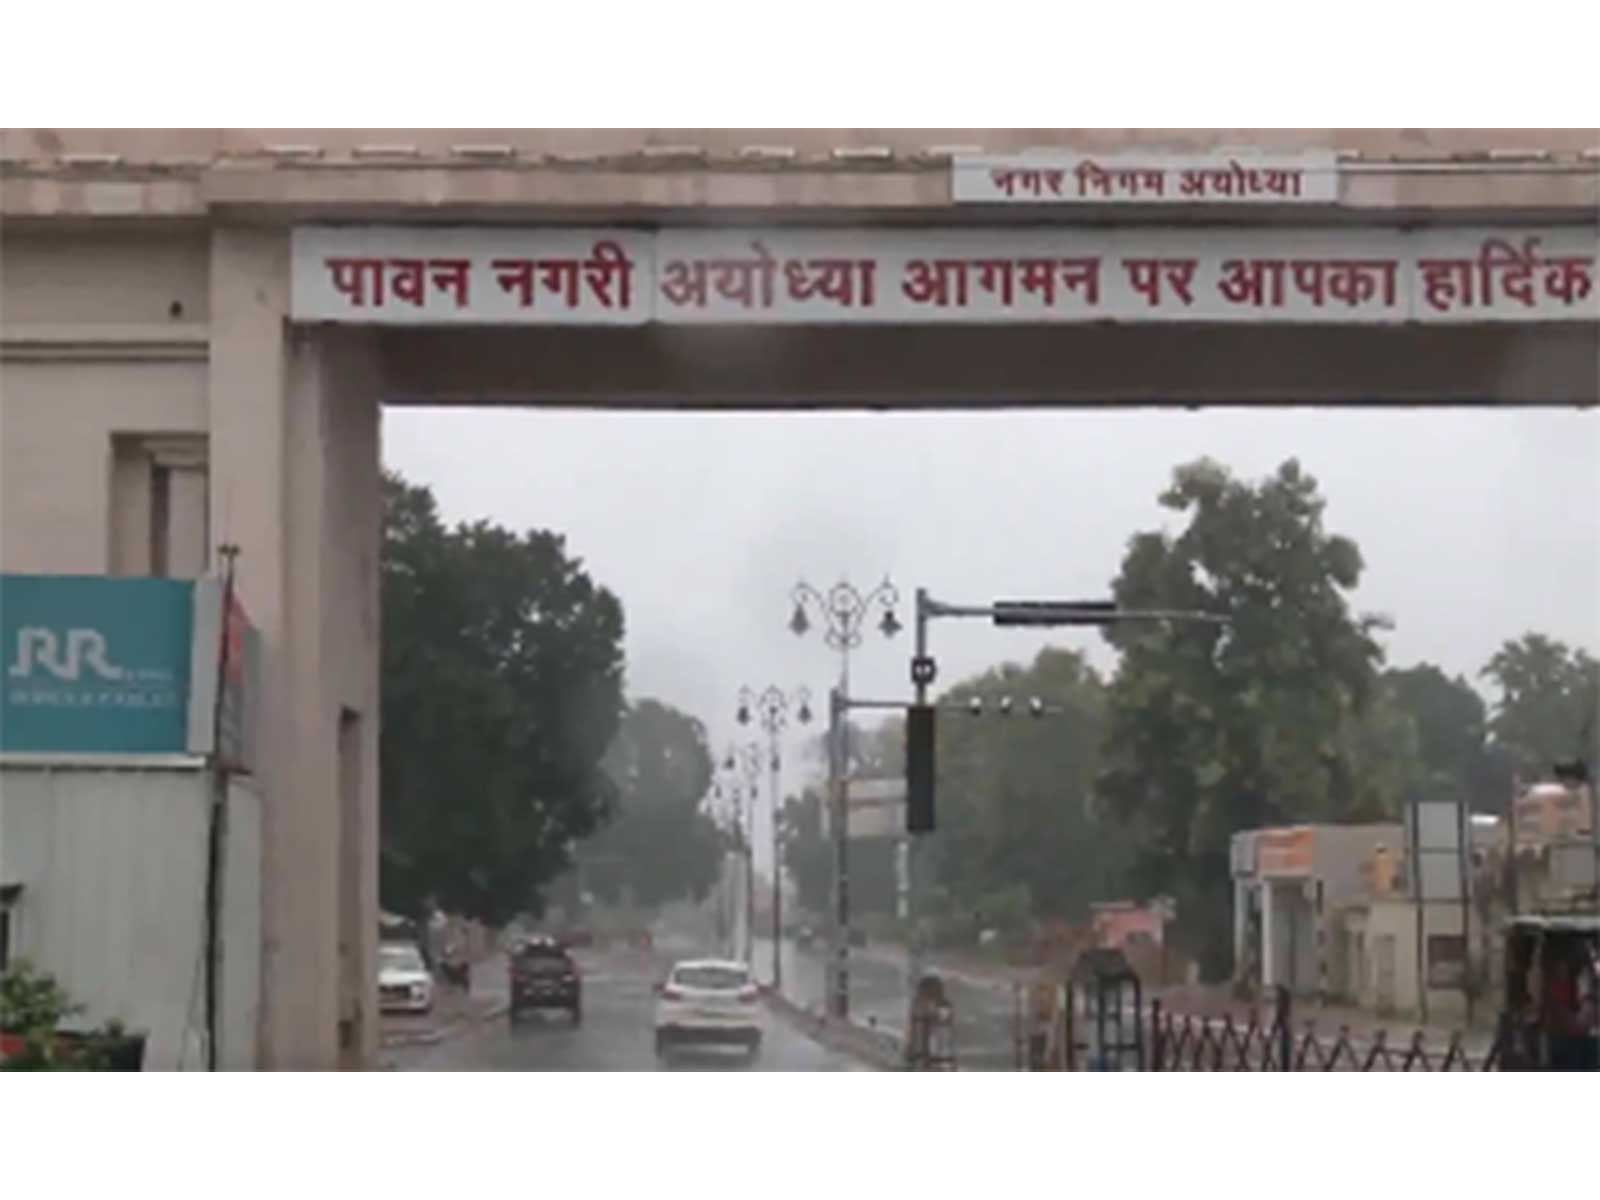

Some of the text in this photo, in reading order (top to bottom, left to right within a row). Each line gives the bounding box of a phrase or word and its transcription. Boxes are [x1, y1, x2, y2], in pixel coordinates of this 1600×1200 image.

[991, 160, 1304, 197] नगर निगम अयोध्या
[325, 237, 1595, 311] पावन नगरी अयोध्या आगमन पर आपका हार्दिक
